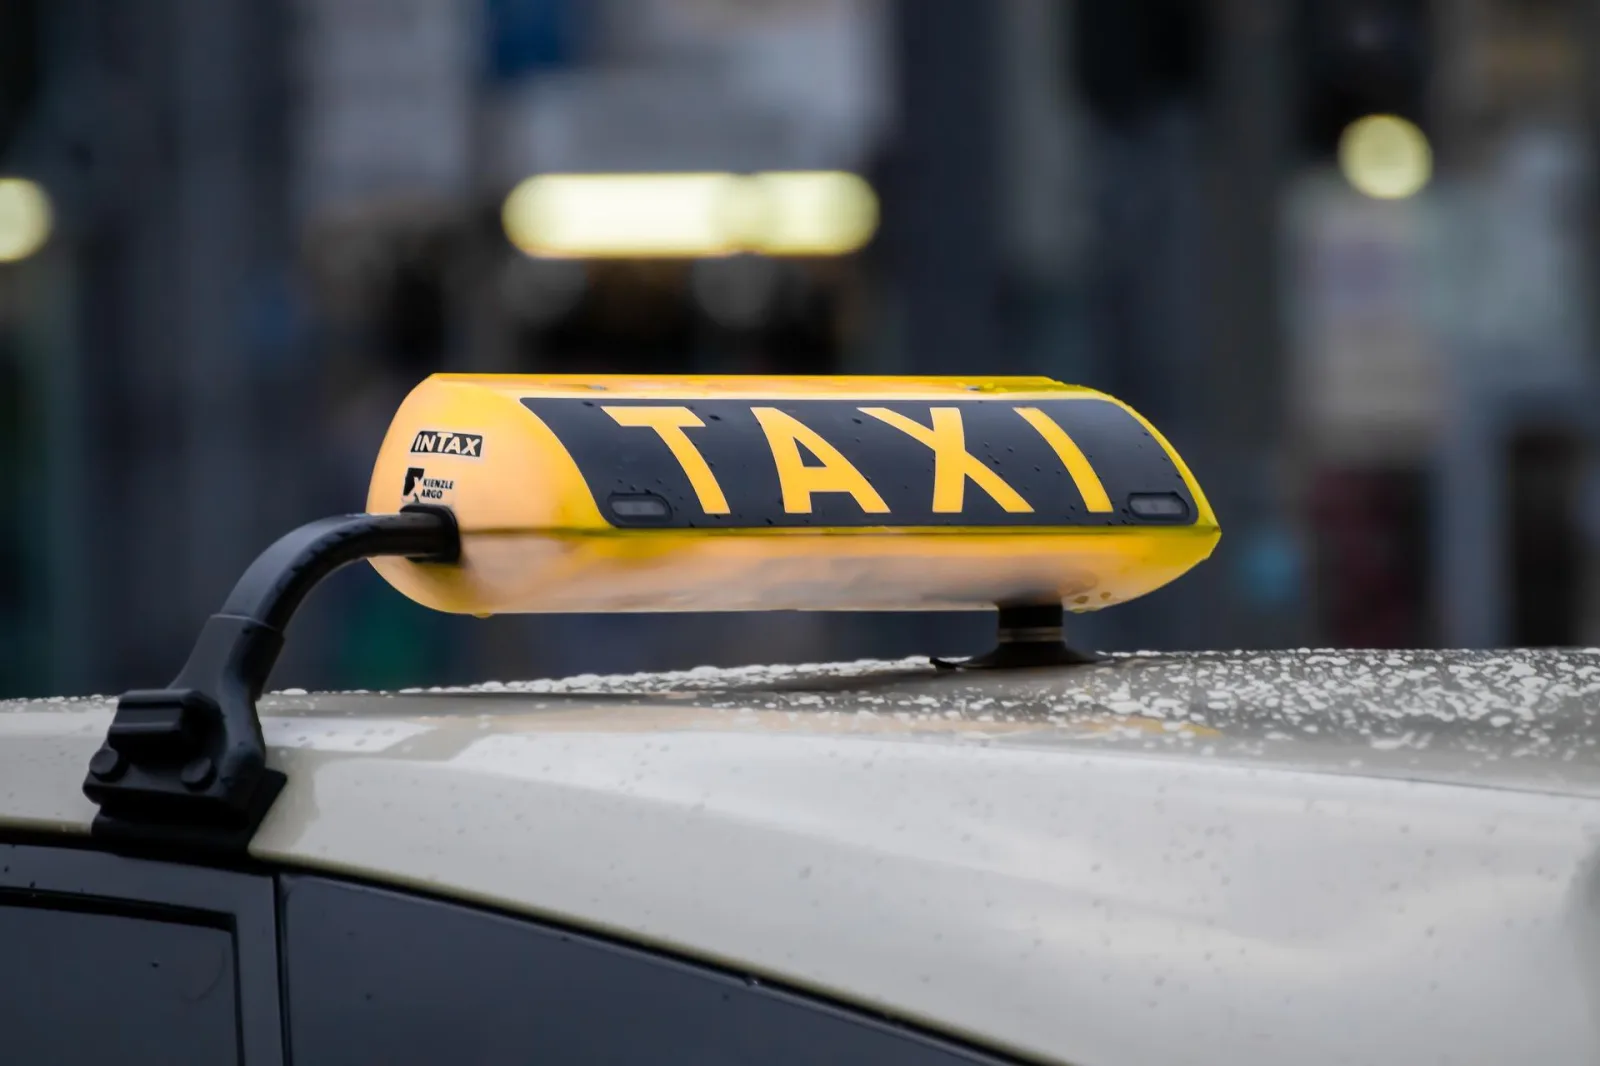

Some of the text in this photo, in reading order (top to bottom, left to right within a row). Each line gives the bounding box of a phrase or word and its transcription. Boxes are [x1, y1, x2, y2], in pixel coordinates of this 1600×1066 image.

[414, 432, 480, 455] INTAX
[601, 406, 1114, 513] TAXI
[423, 479, 453, 489] KIENZLE
[421, 489, 443, 499] ARGO
